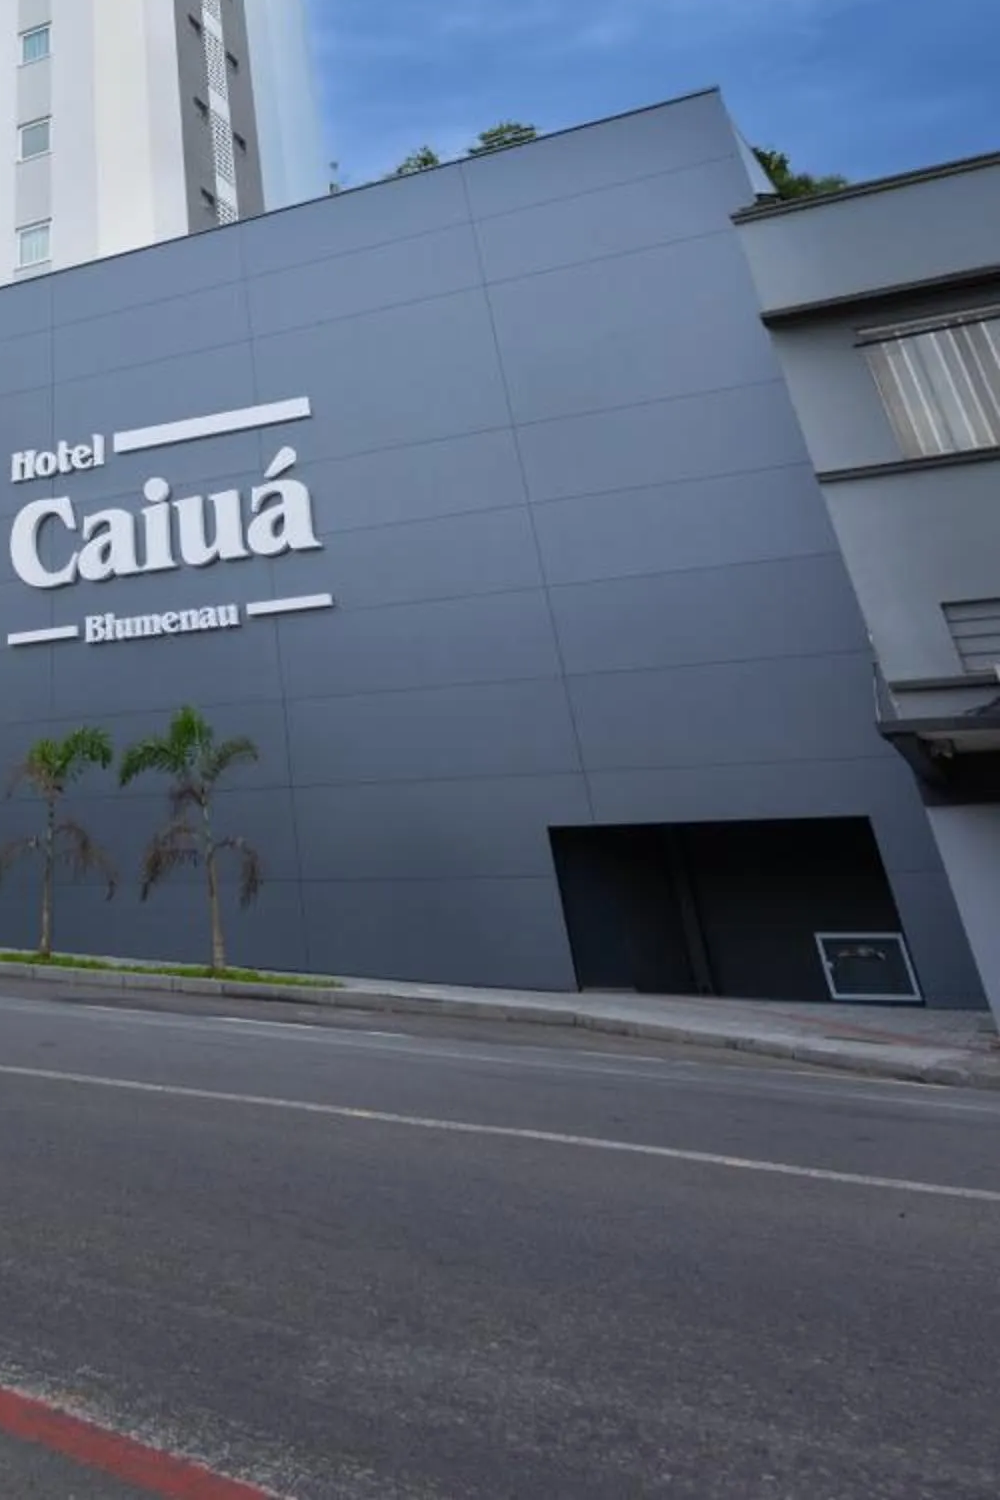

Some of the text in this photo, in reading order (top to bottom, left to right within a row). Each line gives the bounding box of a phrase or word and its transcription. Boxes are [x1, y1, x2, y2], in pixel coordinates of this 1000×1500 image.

[11, 434, 105, 483] Hotel
[10, 446, 323, 588] Caiuá
[85, 604, 240, 643] Blumenau
